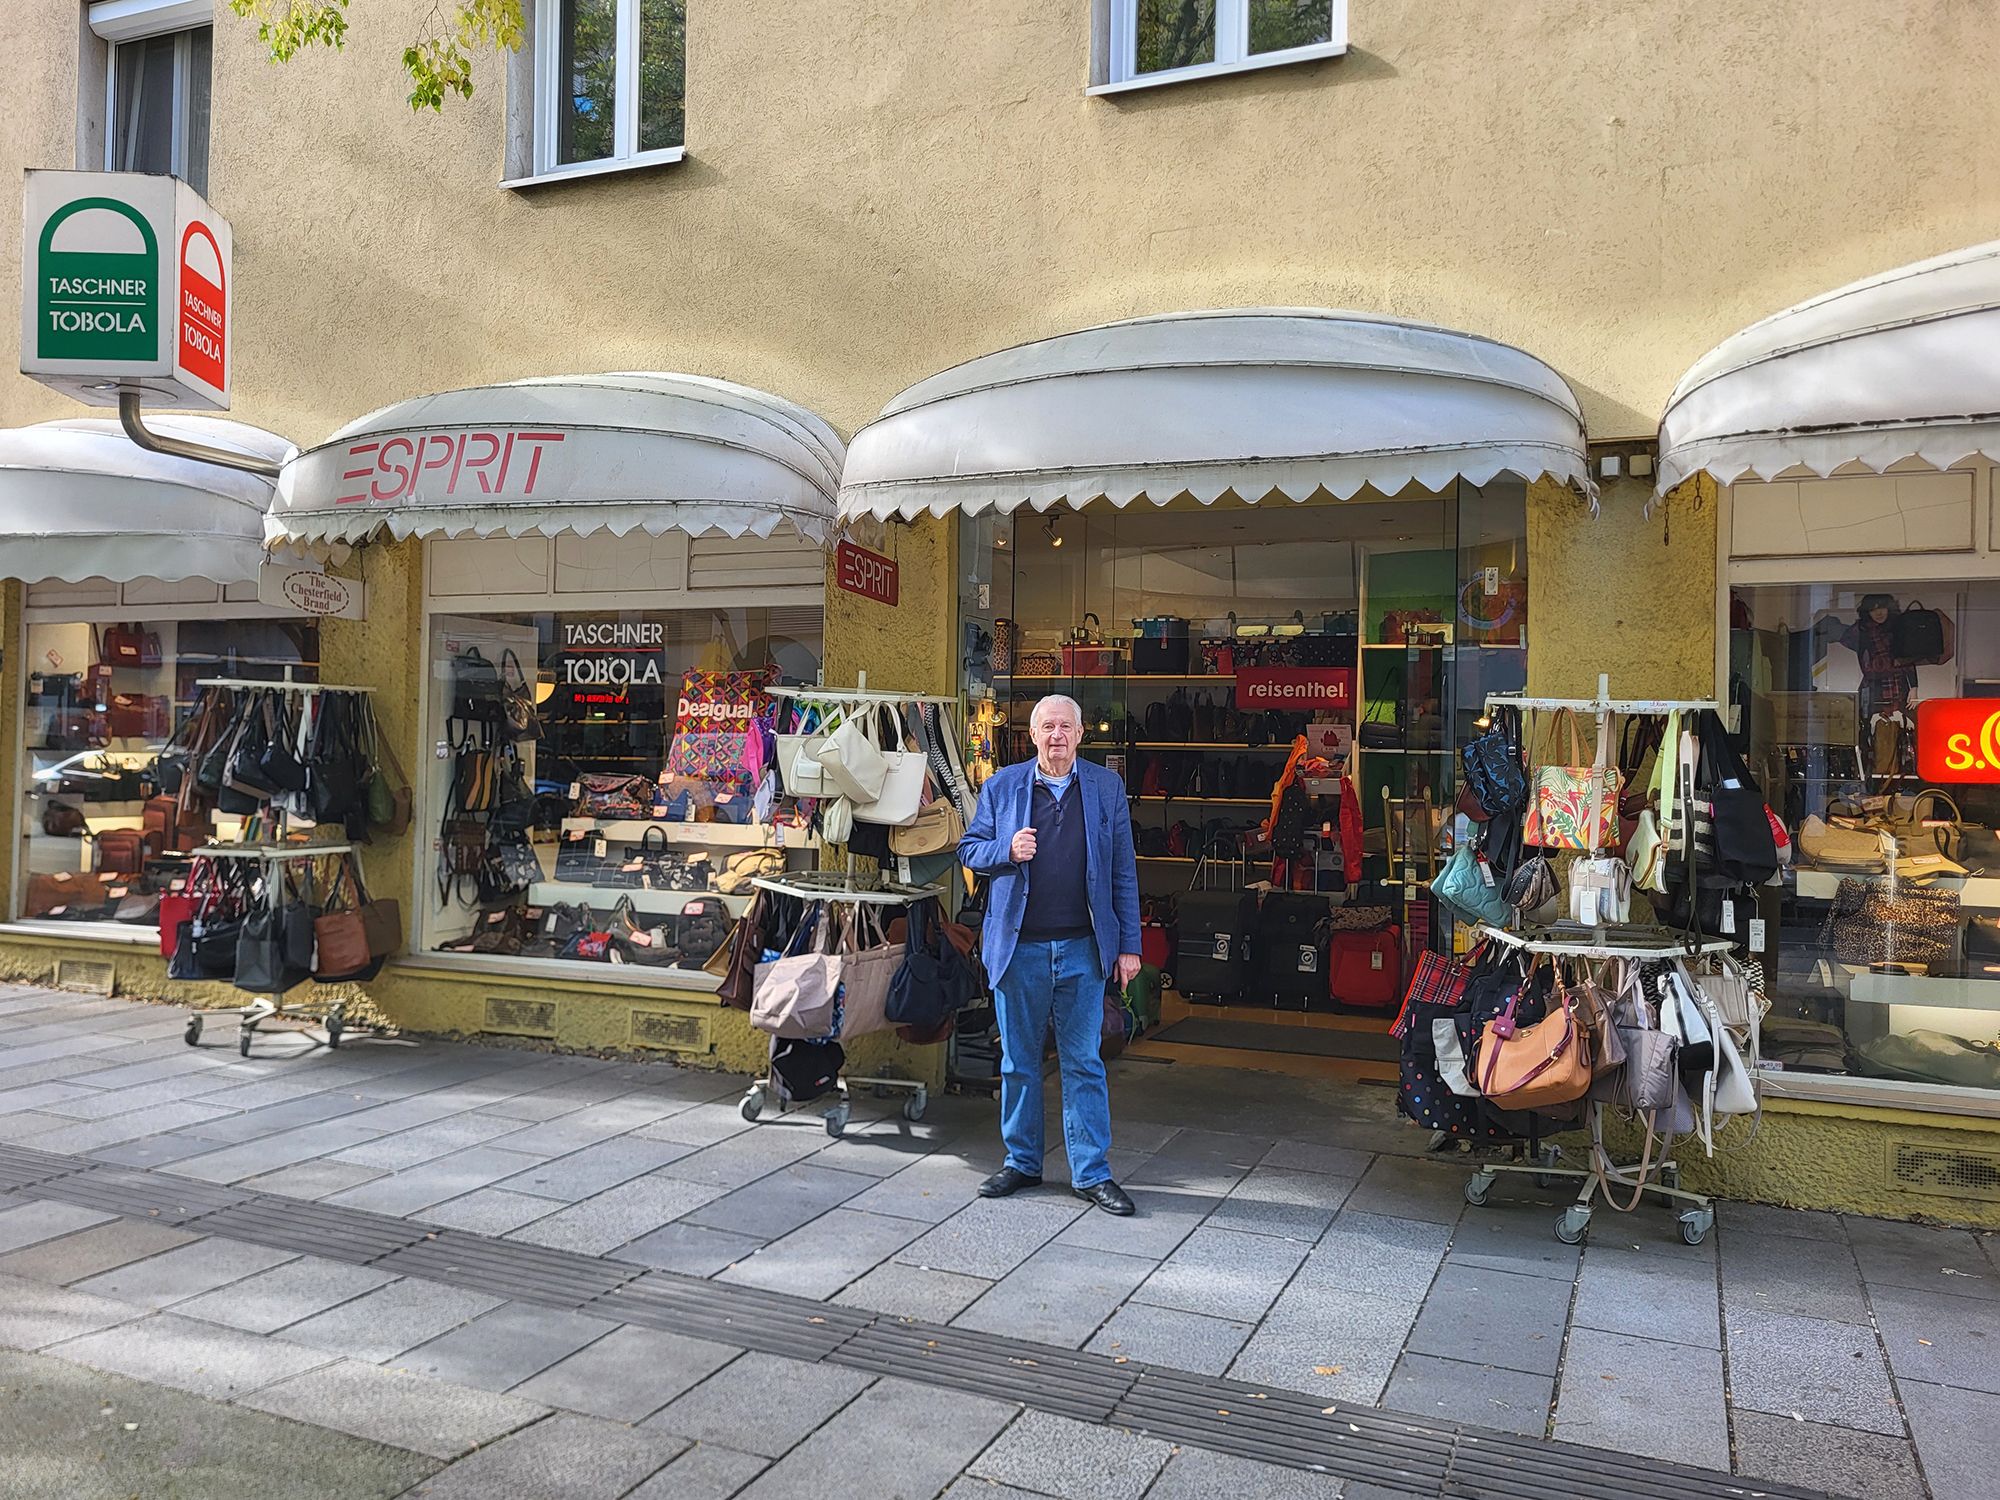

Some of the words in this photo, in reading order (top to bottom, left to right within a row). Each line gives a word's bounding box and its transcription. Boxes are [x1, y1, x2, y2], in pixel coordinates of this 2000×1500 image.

[50, 278, 147, 296] TASCHNER
[184, 289, 222, 329] TASCHNER
[49, 310, 147, 333] TOBOLA
[183, 322, 222, 364] TOBOLA
[335, 432, 565, 504] ESPRIT
[309, 575, 326, 589] The
[845, 550, 893, 598] ESPRIT
[291, 583, 342, 602] Chesterfield
[303, 597, 330, 610] Brand
[565, 623, 663, 645] TASCHNER
[564, 658, 662, 684] TOBOLA
